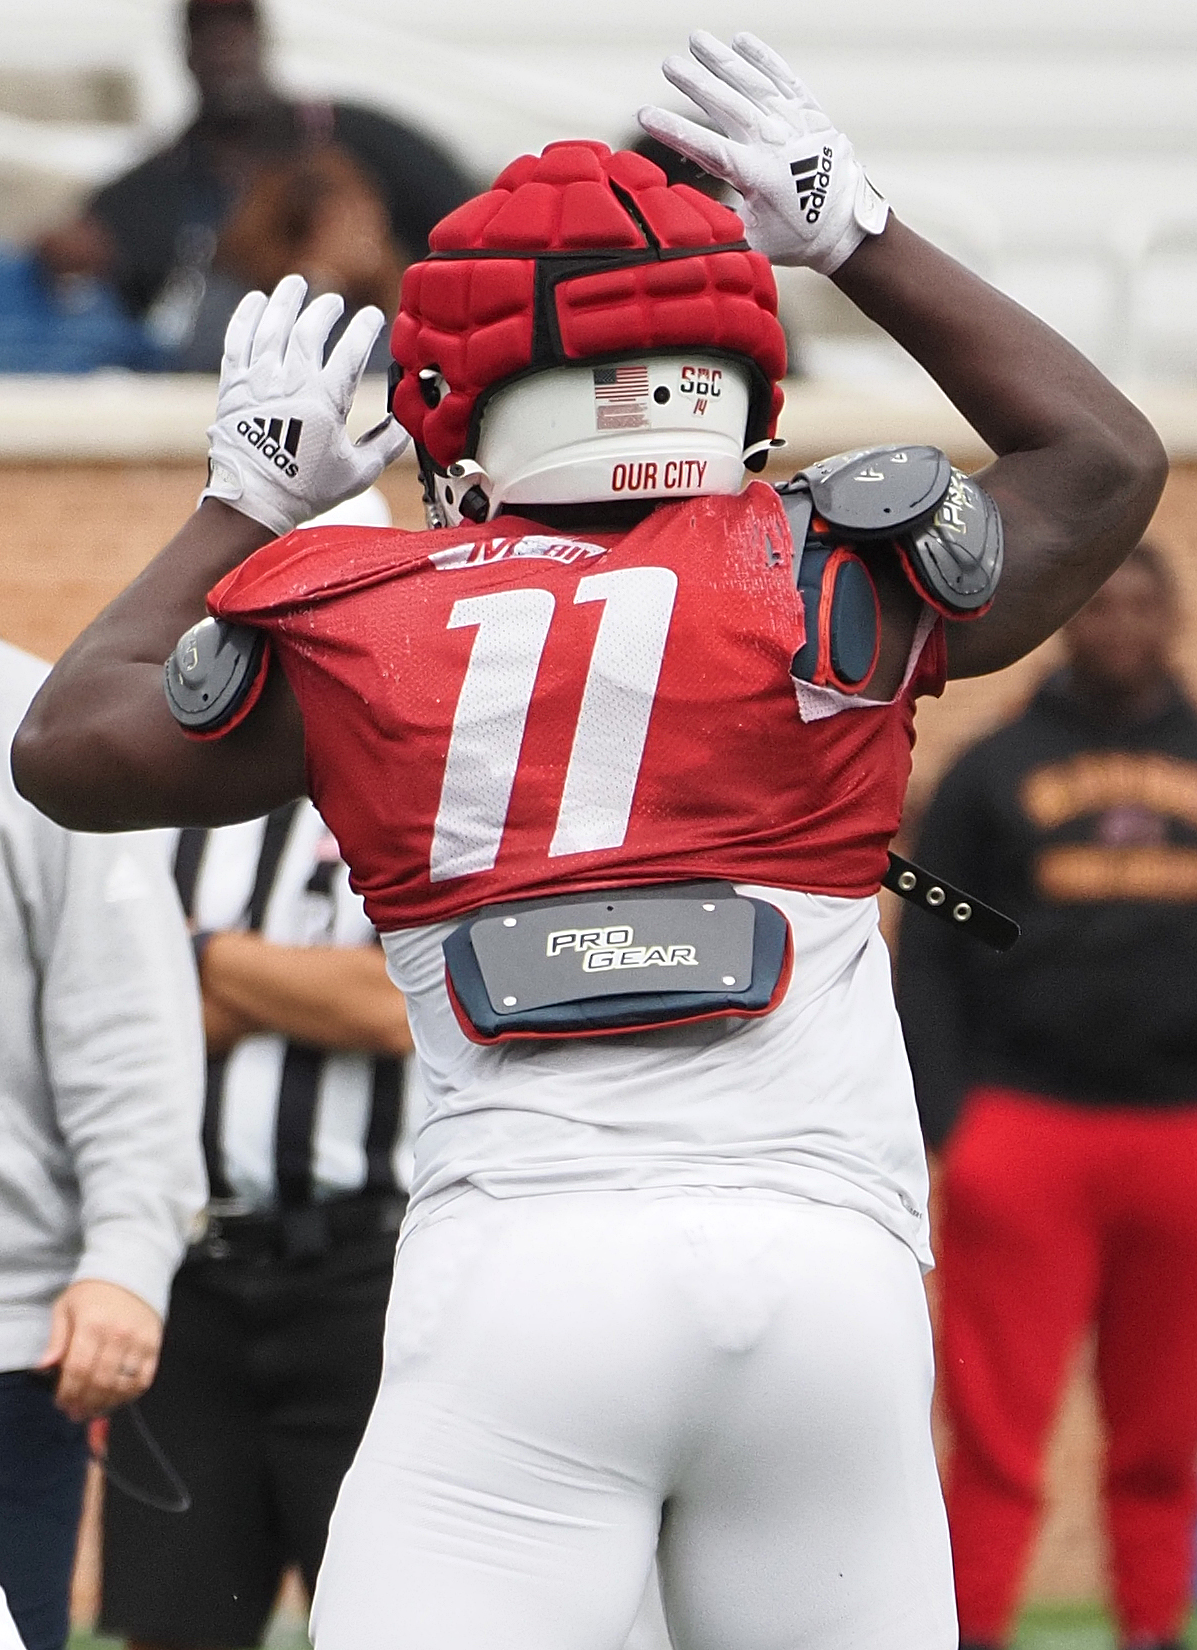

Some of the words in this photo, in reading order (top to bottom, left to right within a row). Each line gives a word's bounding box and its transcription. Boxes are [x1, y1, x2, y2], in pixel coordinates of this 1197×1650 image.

[806, 145, 833, 224] adidas
[680, 365, 723, 398] SBC
[236, 420, 299, 479] adidas
[611, 462, 658, 492] OUR
[664, 460, 708, 489] CITY
[429, 565, 679, 884] 11
[549, 926, 632, 955] PRO
[585, 946, 697, 971] GEAR
